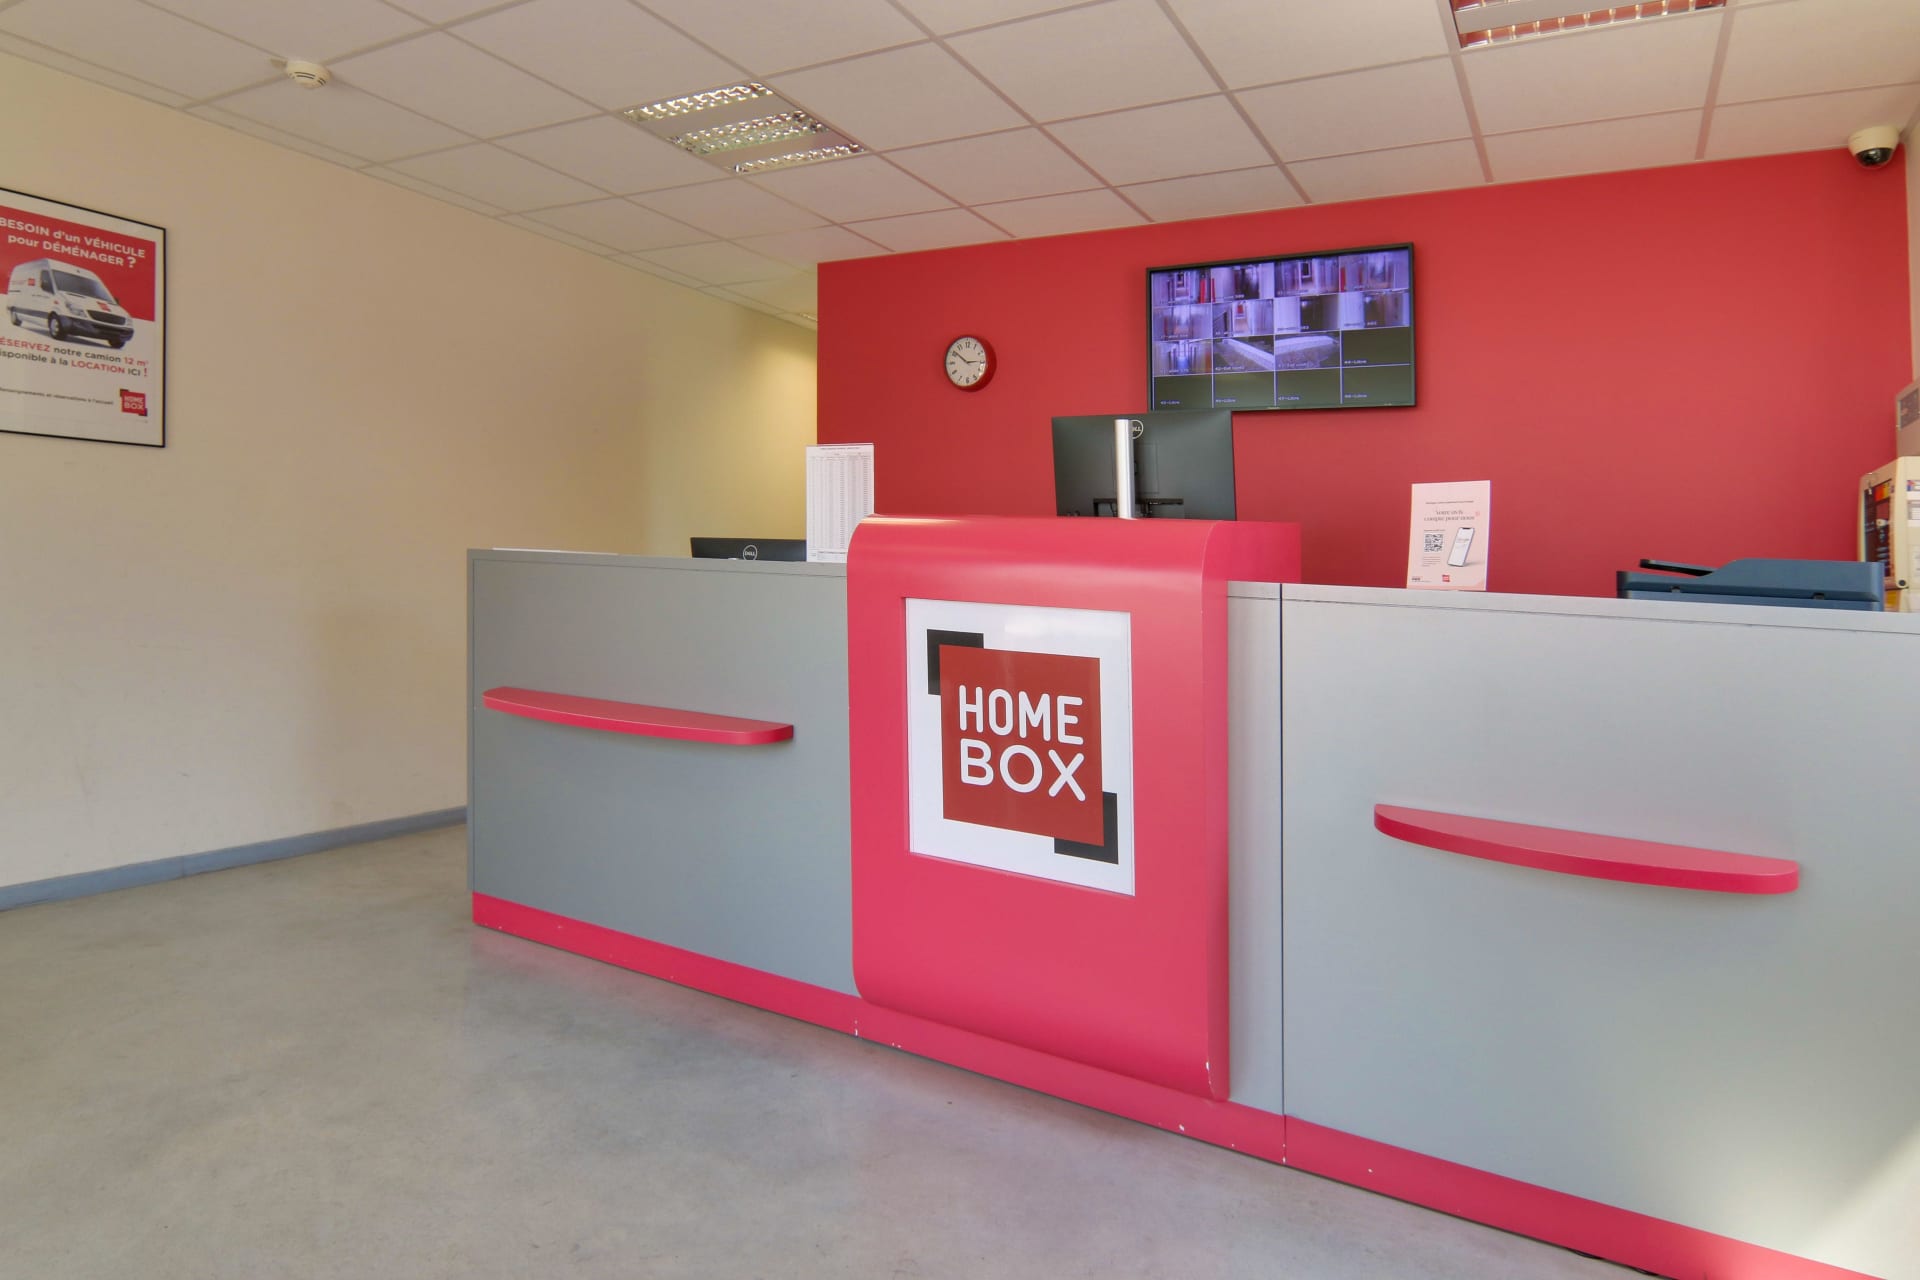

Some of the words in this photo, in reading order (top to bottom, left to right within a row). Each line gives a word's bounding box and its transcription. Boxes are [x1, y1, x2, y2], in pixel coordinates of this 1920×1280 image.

[0, 217, 49, 236] BESOIN
[53, 230, 81, 243] d'un
[84, 236, 146, 258] VÉHICULE
[8, 234, 39, 247] pour
[43, 240, 124, 266] DÉMÉNAGER
[0, 336, 50, 352] ÉSERVEZ
[54, 347, 82, 357] notre
[84, 352, 121, 362] camion
[124, 356, 134, 365] 12
[0, 348, 47, 362] isponible
[59, 358, 68, 366] la
[71, 360, 125, 374] LOCATION
[128, 368, 141, 376] ICI
[124, 401, 145, 410] BOX
[959, 685, 1084, 745] HOME
[960, 738, 1086, 801] BOX
